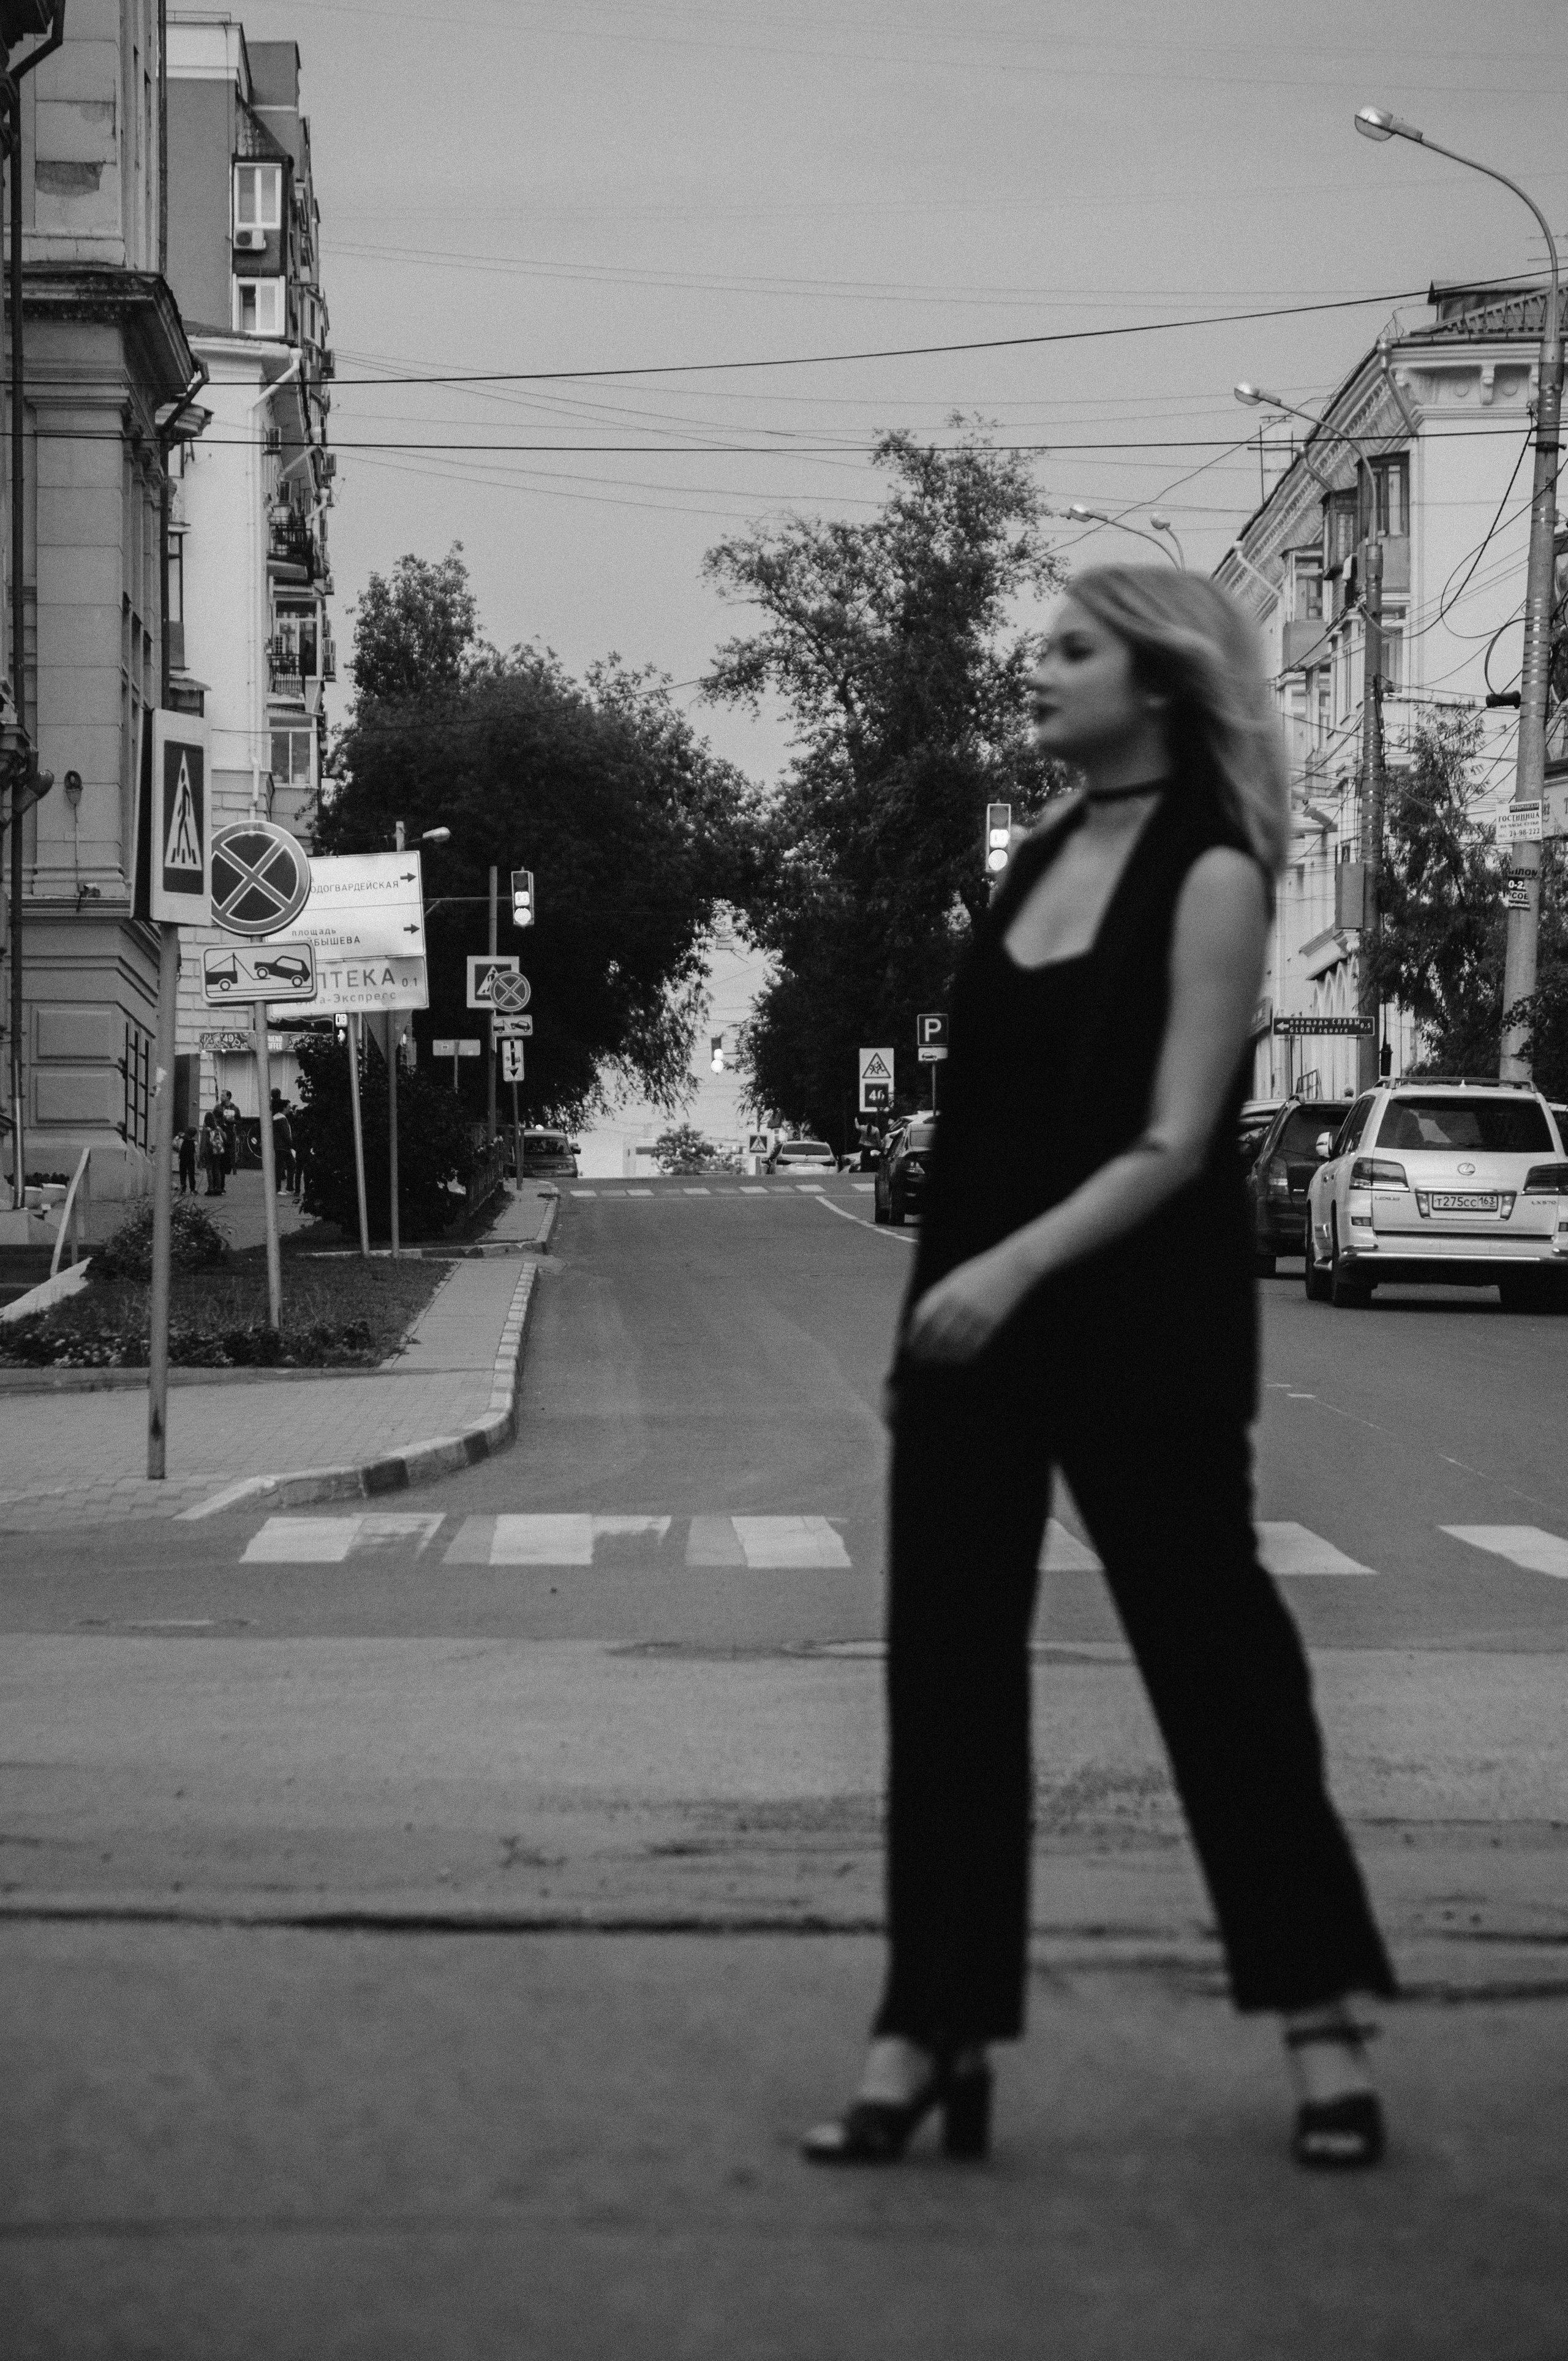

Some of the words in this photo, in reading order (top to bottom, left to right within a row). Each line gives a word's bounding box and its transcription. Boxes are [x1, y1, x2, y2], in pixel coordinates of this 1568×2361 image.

[1498, 812, 1540, 822] ГОСТИНИЦА
[310, 880, 399, 893] ОДОГВАРДЕЙСКАЯ
[292, 928, 337, 937] площадь
[309, 936, 360, 946] БЫШЕВА
[317, 967, 395, 989] ПТЕКА
[924, 1018, 941, 1041] P
